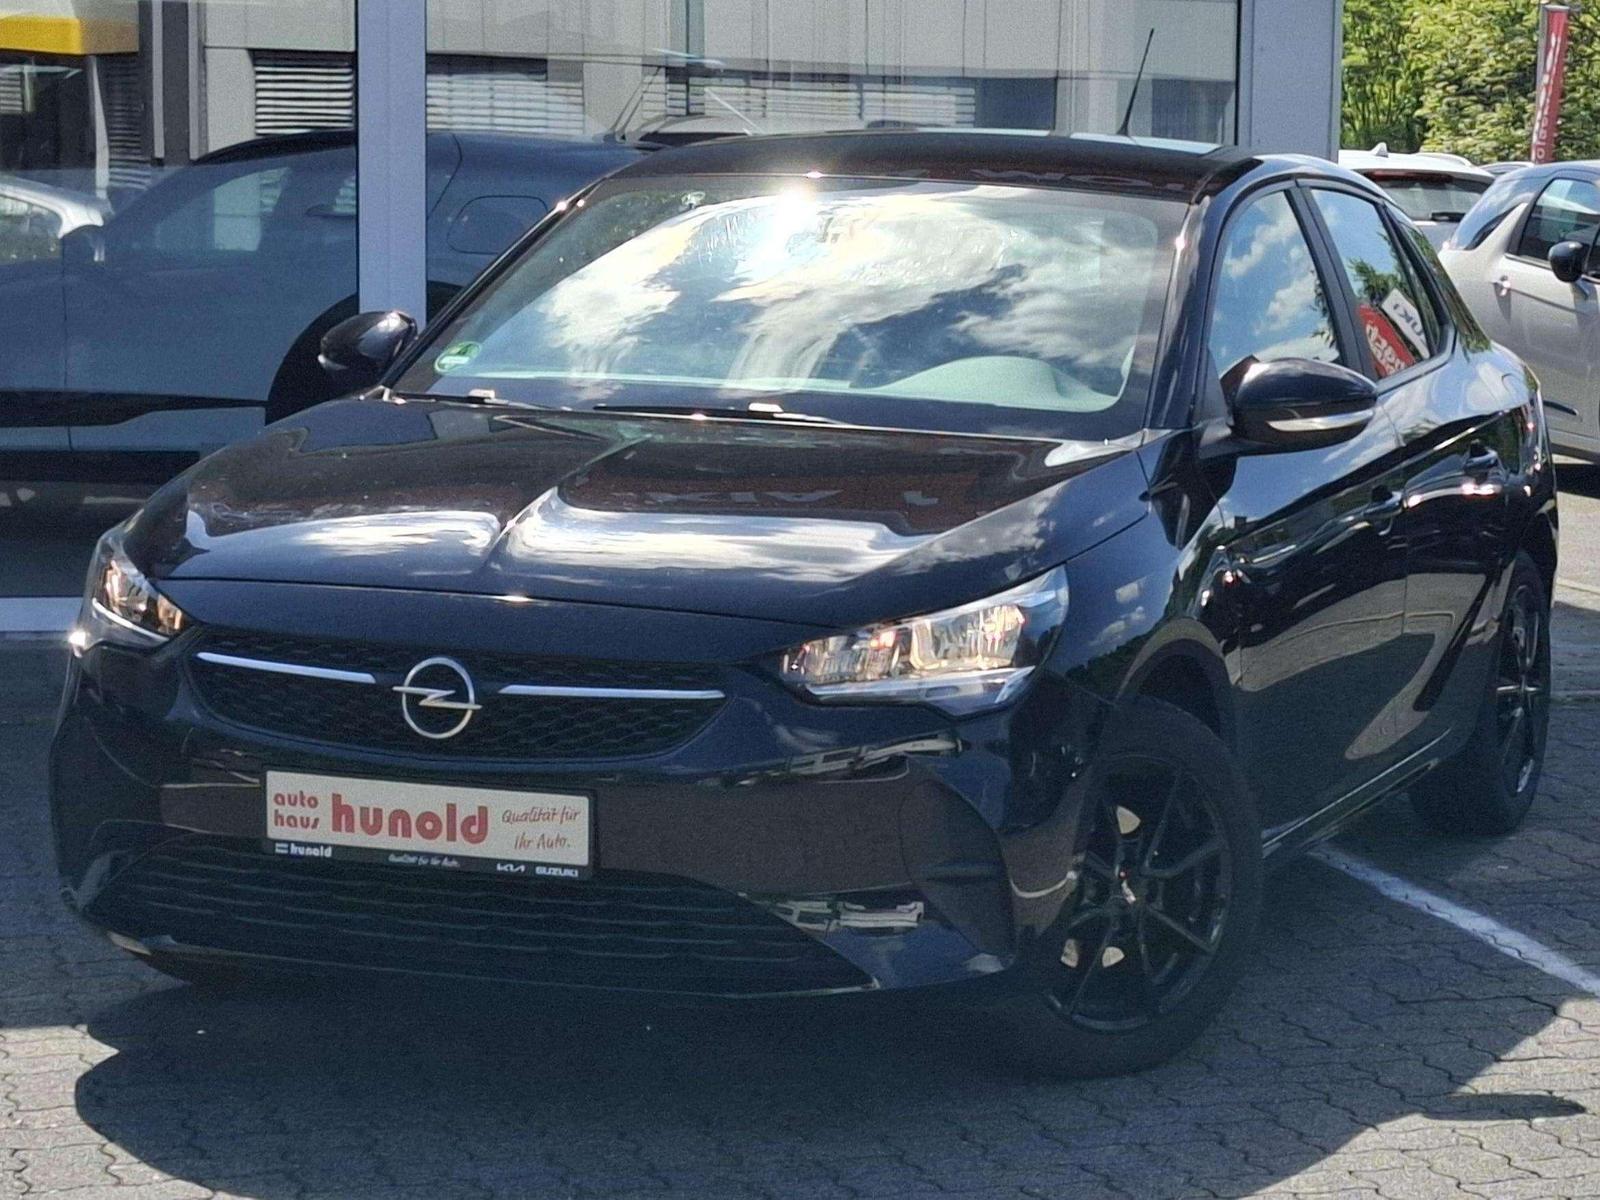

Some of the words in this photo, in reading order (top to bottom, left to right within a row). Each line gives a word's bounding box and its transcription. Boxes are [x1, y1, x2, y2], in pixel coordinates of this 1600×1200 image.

[273, 790, 319, 809] auto
[273, 809, 320, 829] haus
[331, 792, 488, 846] hunold
[290, 842, 333, 858] hunold
[514, 832, 532, 850] Ihr
